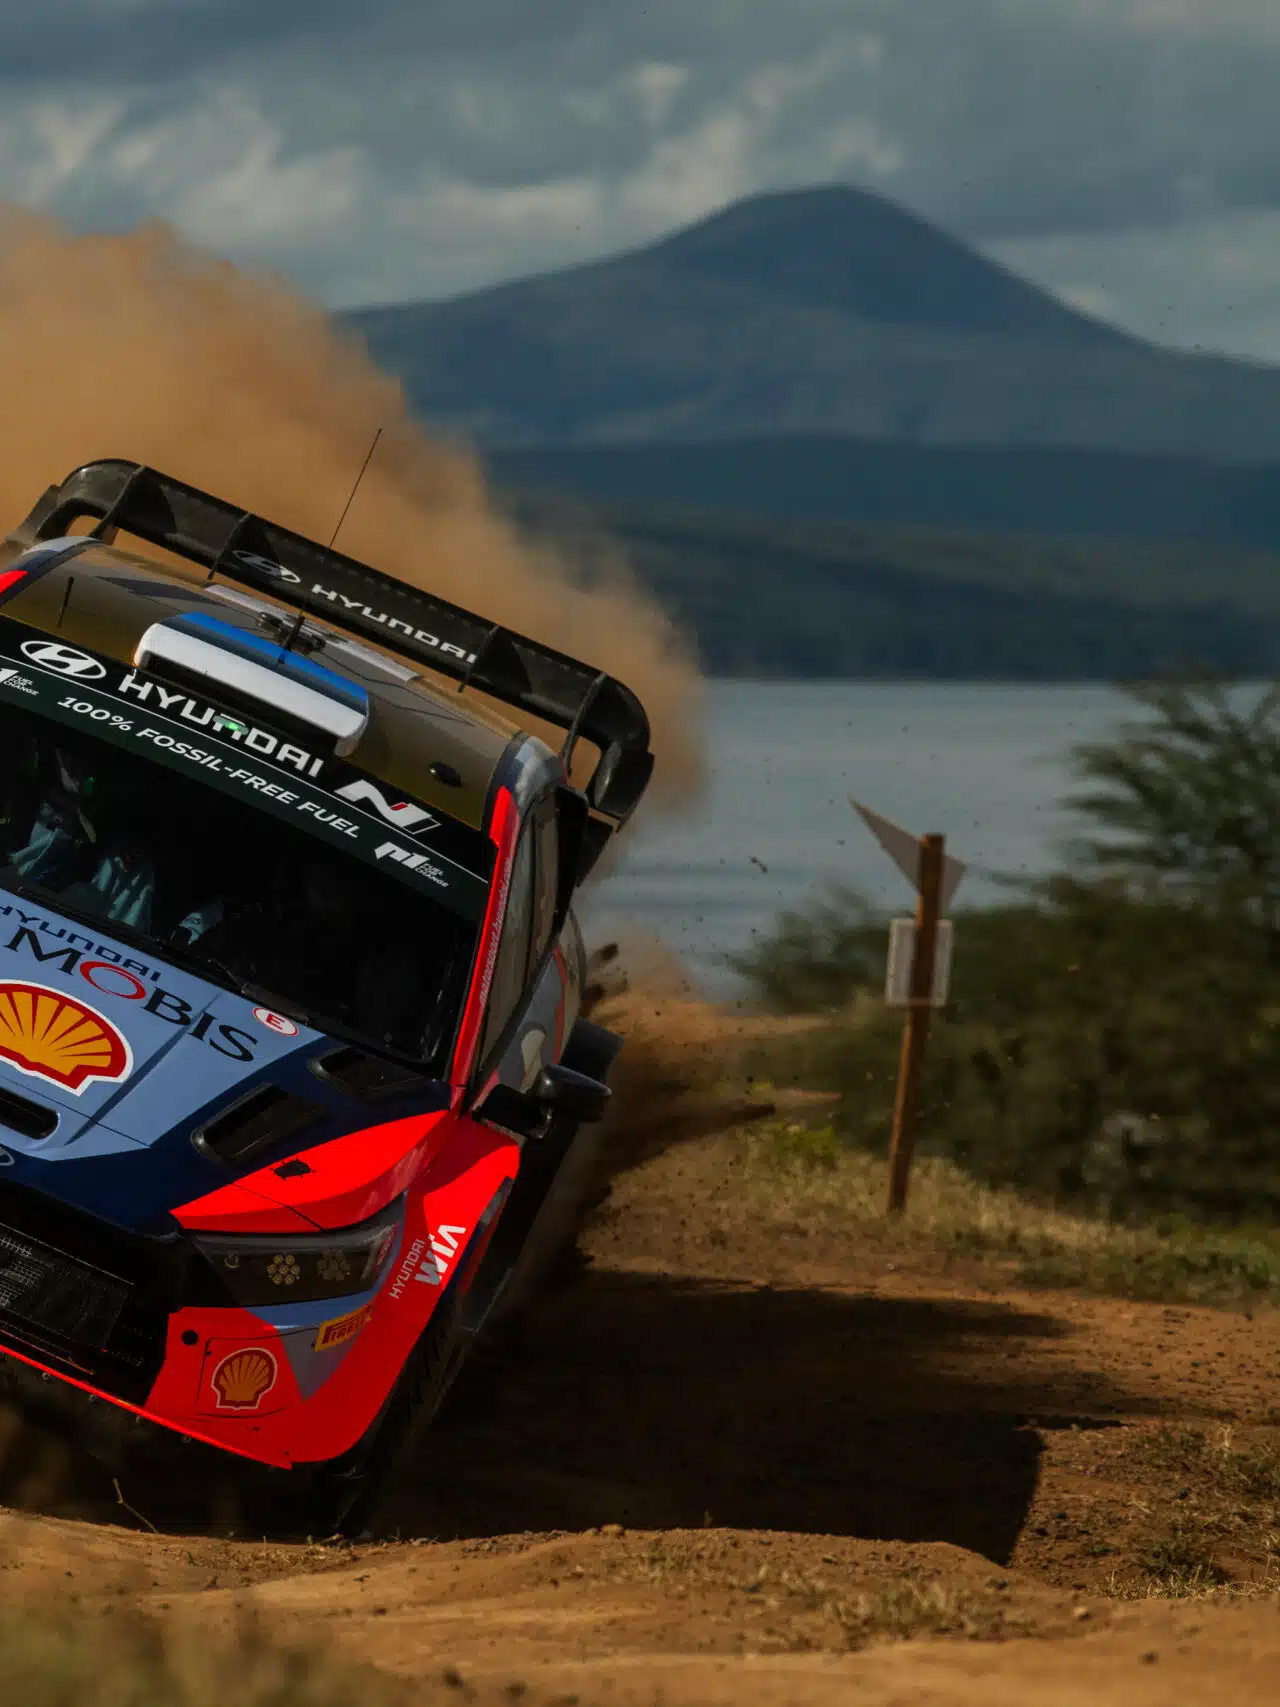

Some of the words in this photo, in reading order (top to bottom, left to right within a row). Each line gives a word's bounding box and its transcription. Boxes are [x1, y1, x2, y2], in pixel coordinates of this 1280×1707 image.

[312, 584, 479, 665] HYUNDAI
[57, 696, 133, 732] 100%
[136, 728, 308, 808] FOSSIL-FREE
[296, 800, 363, 839] FUEL
[119, 675, 324, 778] HYUNDAI
[4, 928, 259, 1062] MOBIS
[264, 1013, 286, 1028] E
[388, 1238, 426, 1299] HYUNDAI
